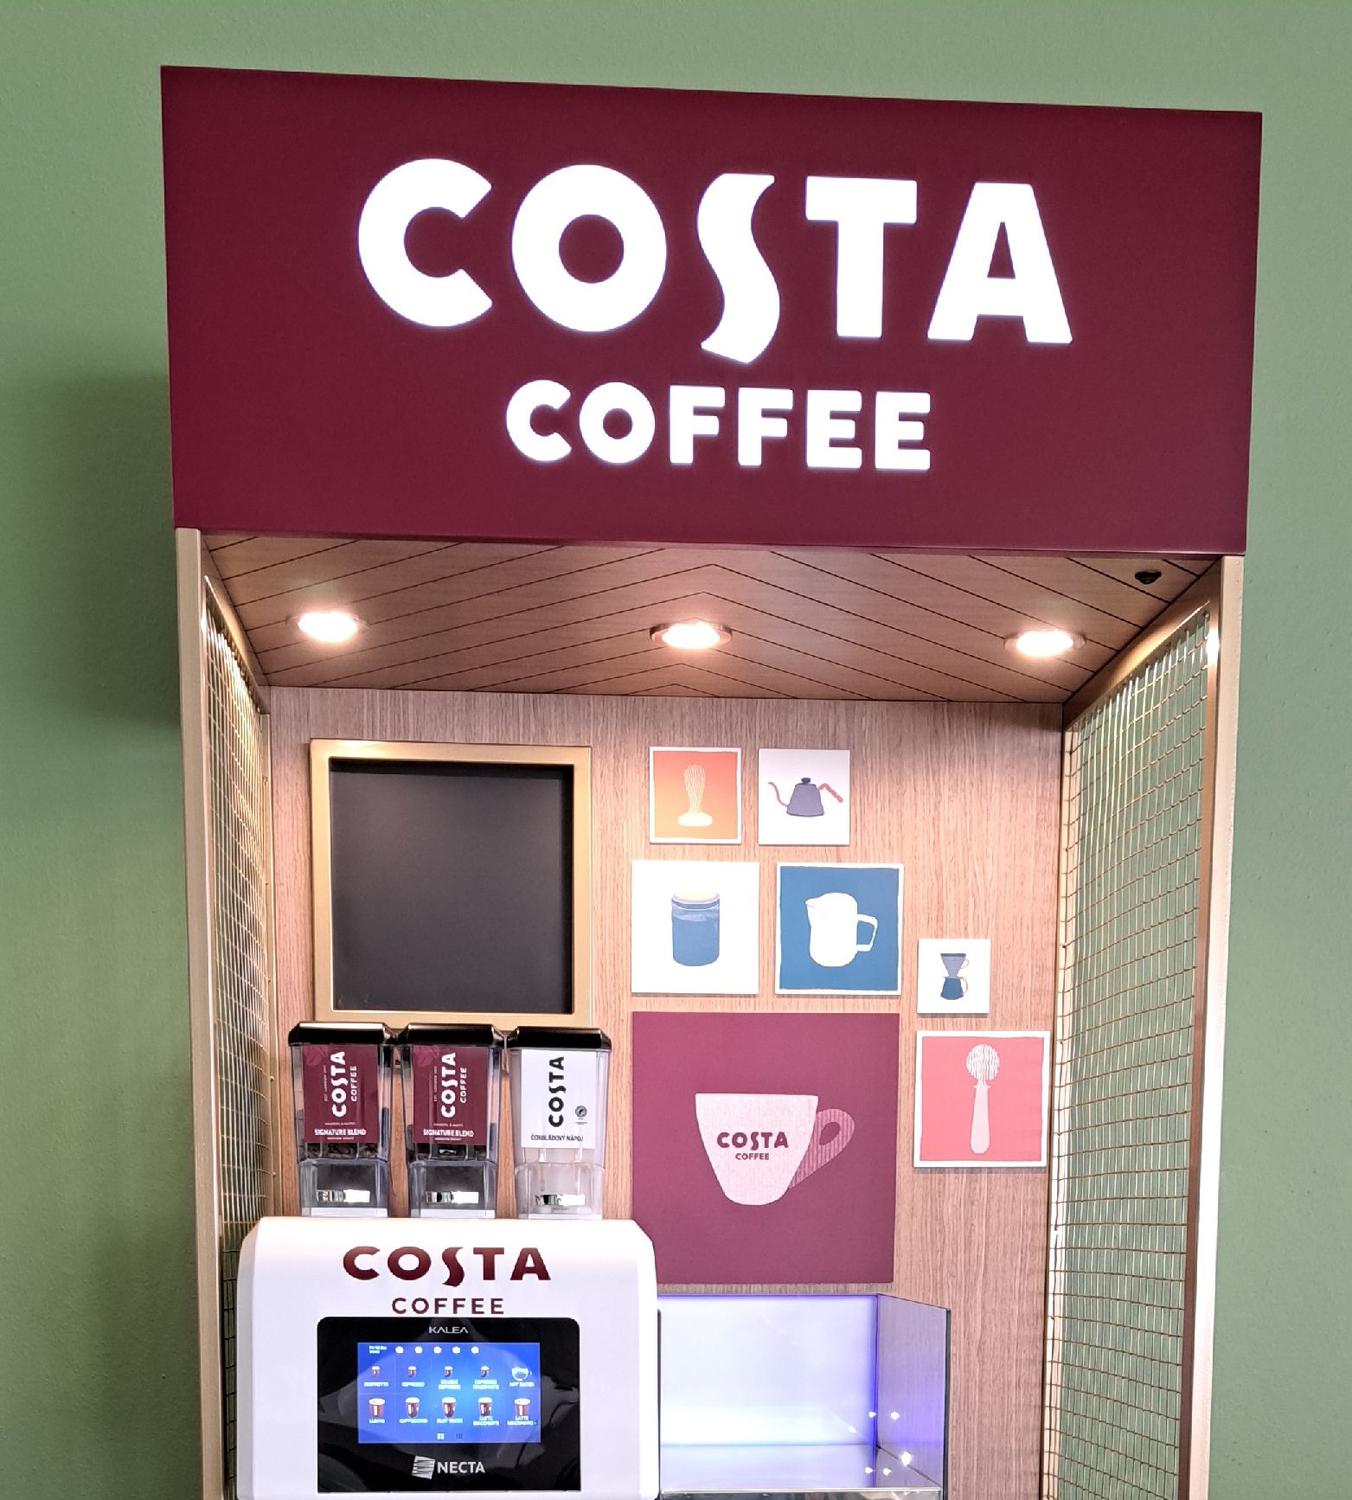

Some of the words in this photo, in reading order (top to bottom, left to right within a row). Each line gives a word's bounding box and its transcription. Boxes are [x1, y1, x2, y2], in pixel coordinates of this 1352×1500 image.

[357, 157, 1074, 364] COSTA
[505, 379, 932, 472] COFFEE
[330, 1051, 349, 1118] COSTA
[350, 1065, 358, 1102] COFFEE
[441, 1052, 459, 1118] COSTA
[460, 1067, 468, 1104] COFFEE
[548, 1056, 567, 1128] COSTA
[347, 1128, 367, 1136] BLEND
[716, 1131, 789, 1151] COSTA
[735, 1152, 770, 1161] COFFEE
[342, 1245, 552, 1288] COSTA
[391, 1297, 505, 1315] COFFEE
[428, 1325, 470, 1335] KALEA
[436, 1461, 486, 1475] NECTA
